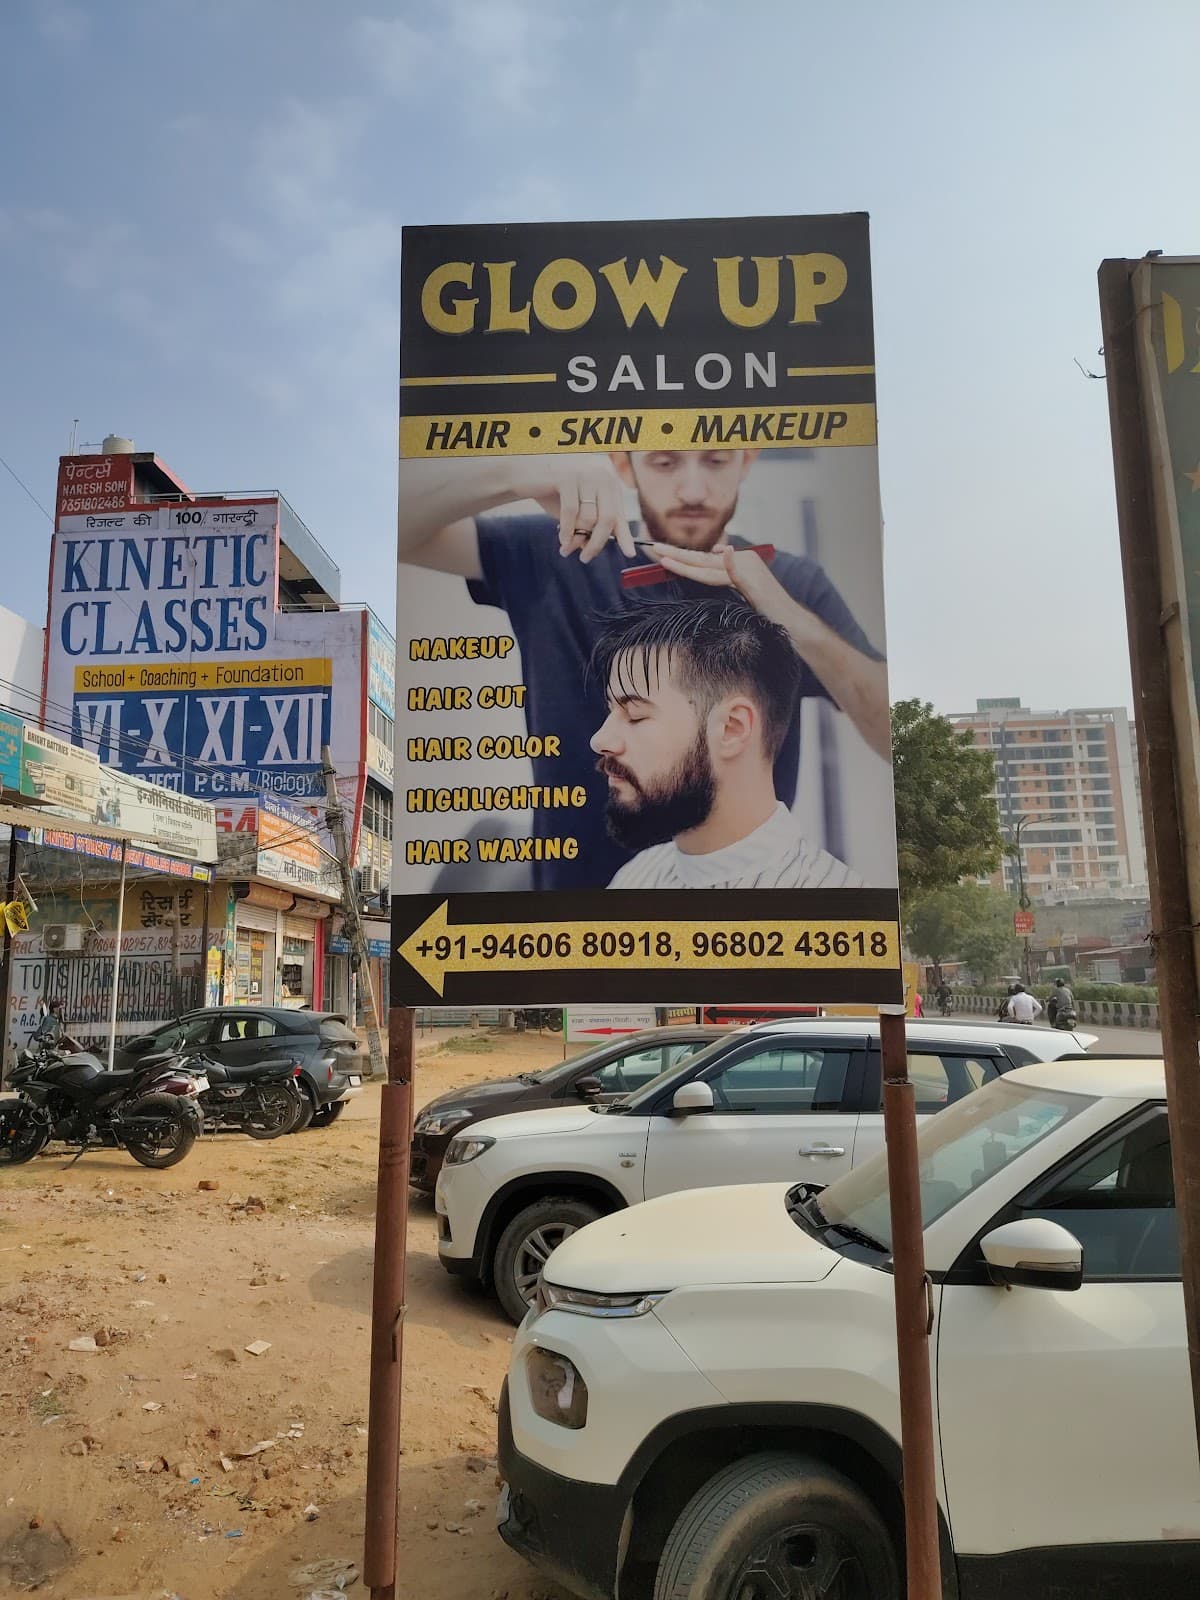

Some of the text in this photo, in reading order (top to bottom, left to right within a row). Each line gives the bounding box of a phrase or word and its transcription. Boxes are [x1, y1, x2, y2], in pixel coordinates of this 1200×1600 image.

[421, 252, 849, 335] GLOW UP
[567, 351, 777, 394] SALON
[425, 411, 848, 450] HAIR SKIN MAKEUP
[63, 480, 127, 496] NARESH SONI
[86, 516, 126, 529] रिजल्ट
[133, 513, 152, 527] की
[61, 533, 268, 593] KINETIC
[61, 595, 267, 655] CLASSES
[409, 635, 515, 662] MAKEUP
[83, 670, 125, 688] School
[140, 668, 196, 689] Coaching
[216, 663, 304, 684] Foundation
[407, 685, 527, 711] HAIR CUT
[27, 731, 46, 747] BRIGHT
[407, 737, 471, 762] HAIR
[478, 735, 561, 760] COLOR
[406, 785, 587, 812] HIGHLIGHTING
[43, 830, 75, 850] UNITED
[76, 835, 111, 859] STUDENT
[110, 845, 143, 866] ACDEMY
[406, 837, 579, 864] HAIR WAXING
[415, 932, 572, 960] +91-94606
[582, 930, 681, 961] 80918,
[692, 930, 785, 957] 96802
[794, 930, 888, 957] 43618
